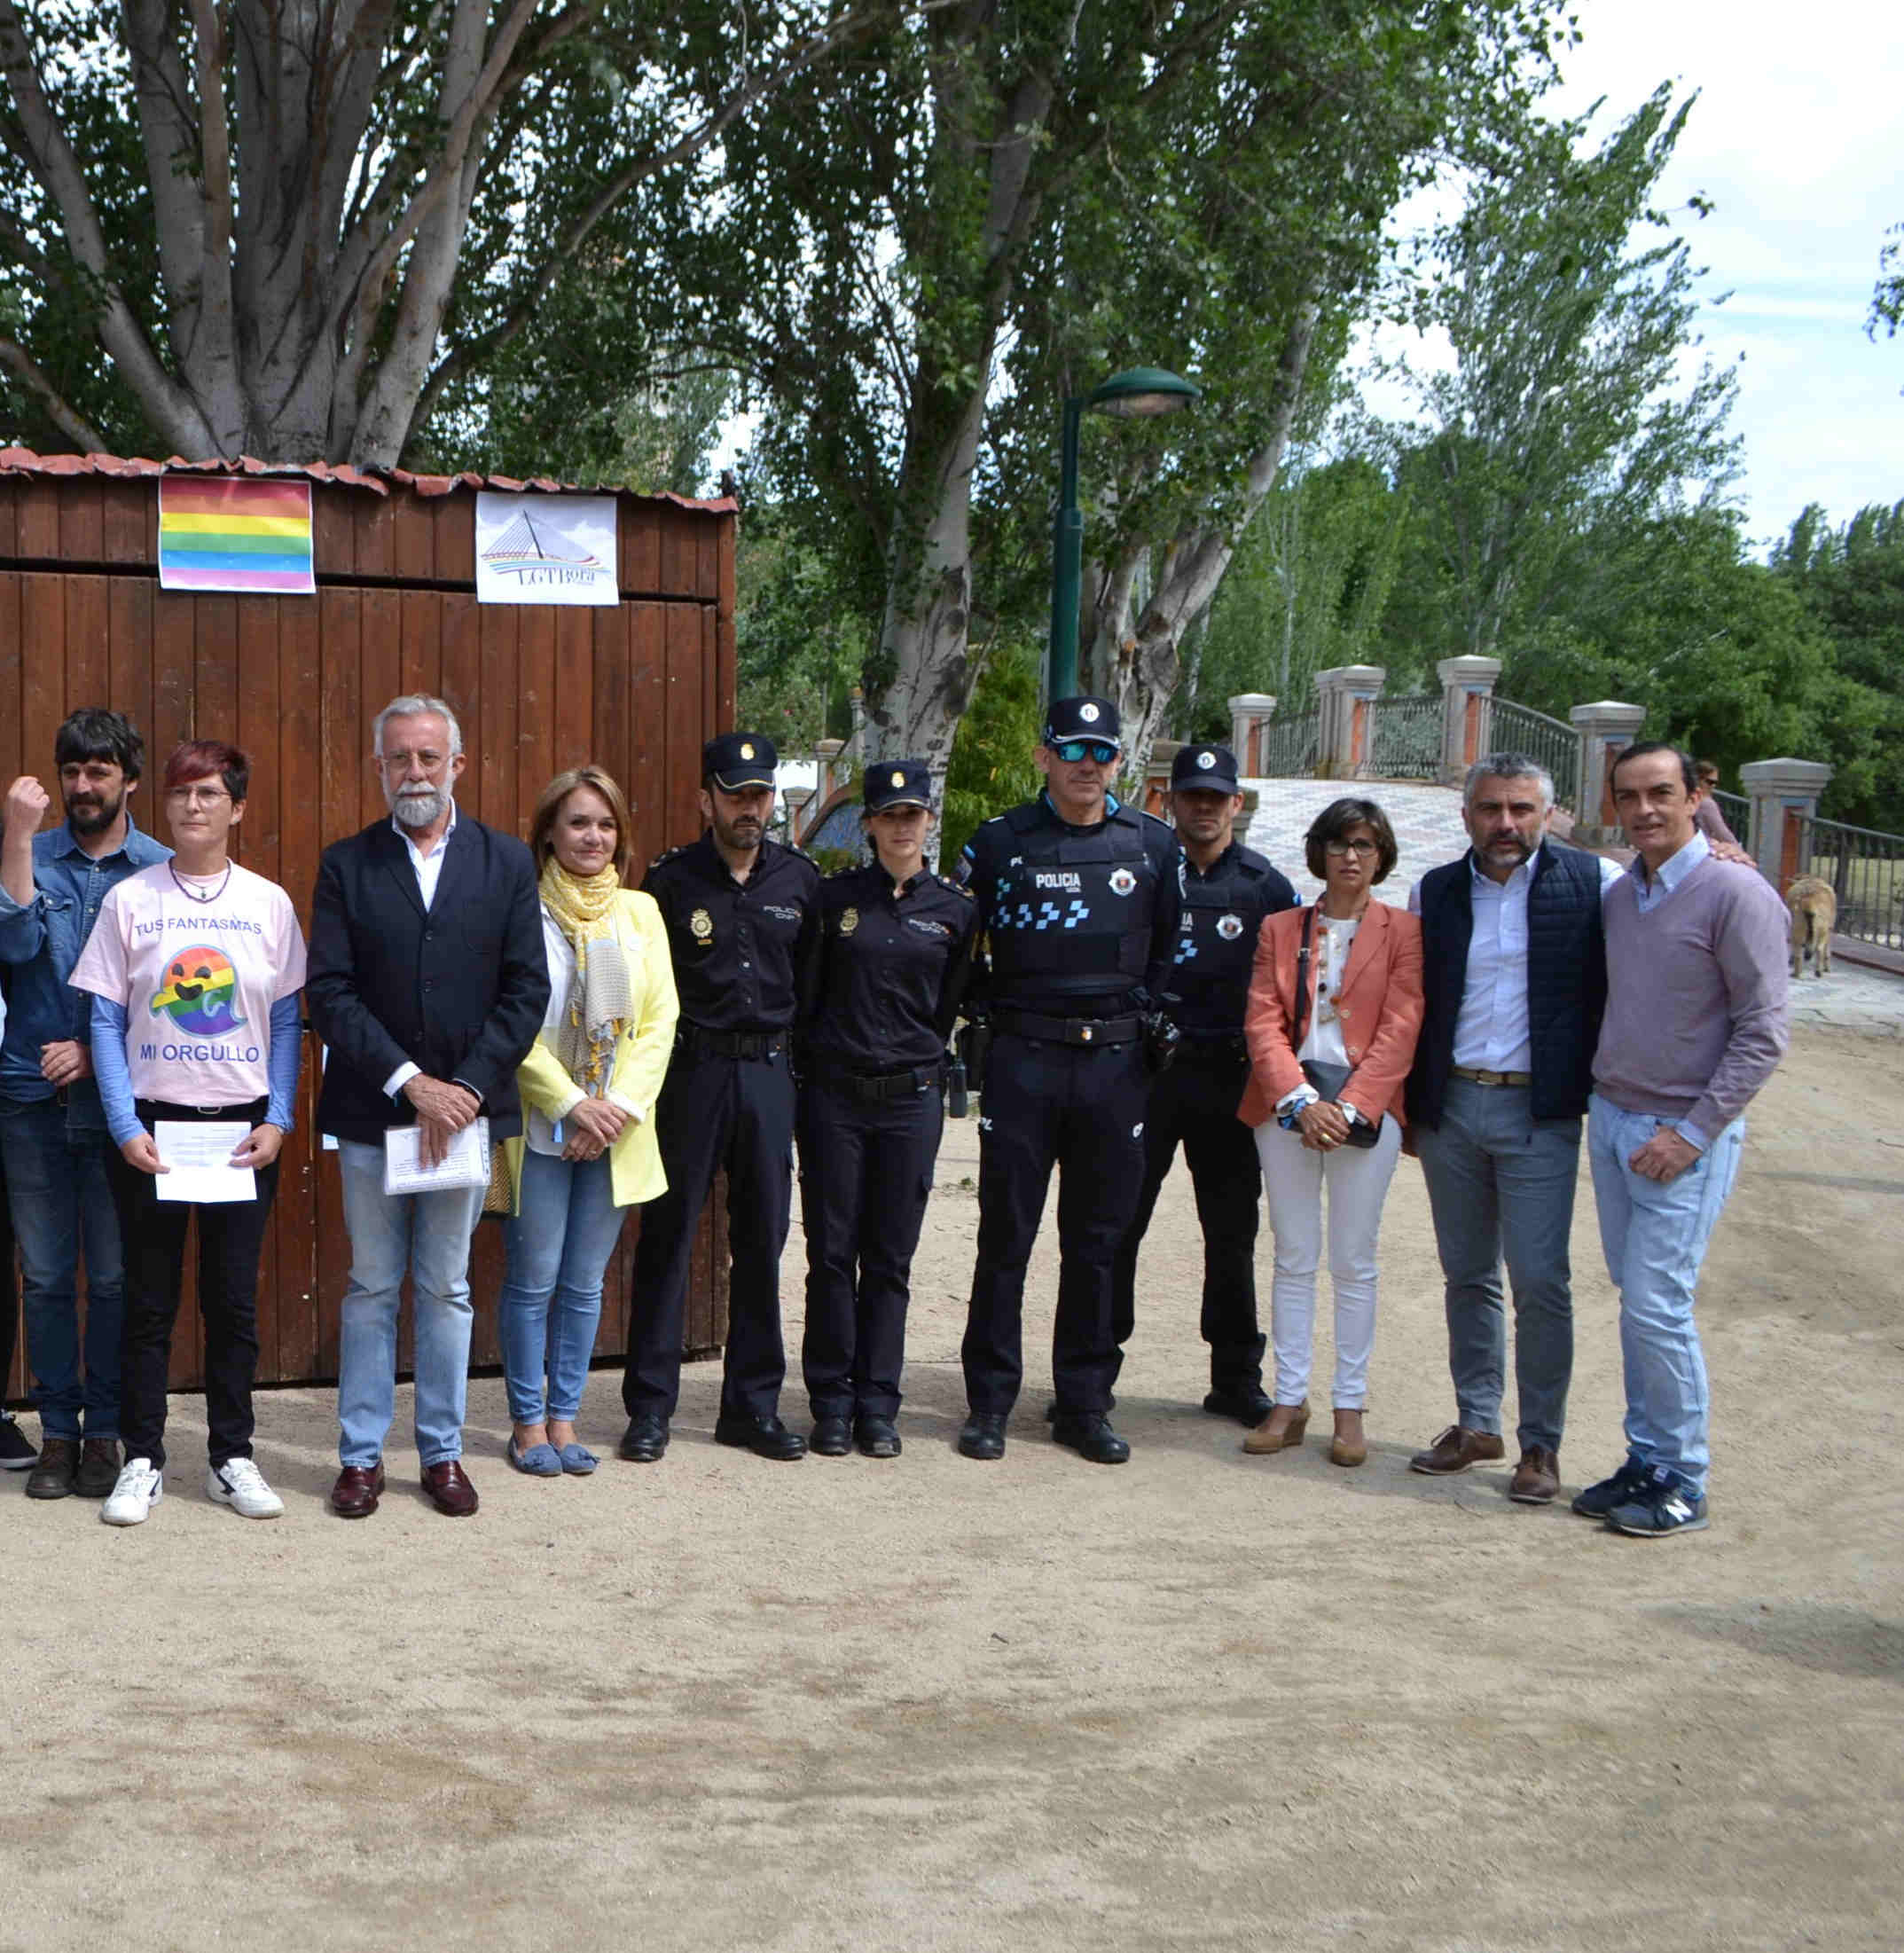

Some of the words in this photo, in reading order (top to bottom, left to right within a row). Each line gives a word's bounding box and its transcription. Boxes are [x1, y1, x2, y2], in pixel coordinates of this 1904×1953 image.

[1035, 873, 1082, 889] POLICIA
[135, 919, 164, 937] TUS
[168, 917, 262, 935] FANTASMAS
[141, 1044, 156, 1061] MI
[162, 1044, 260, 1063] ORGULLO
